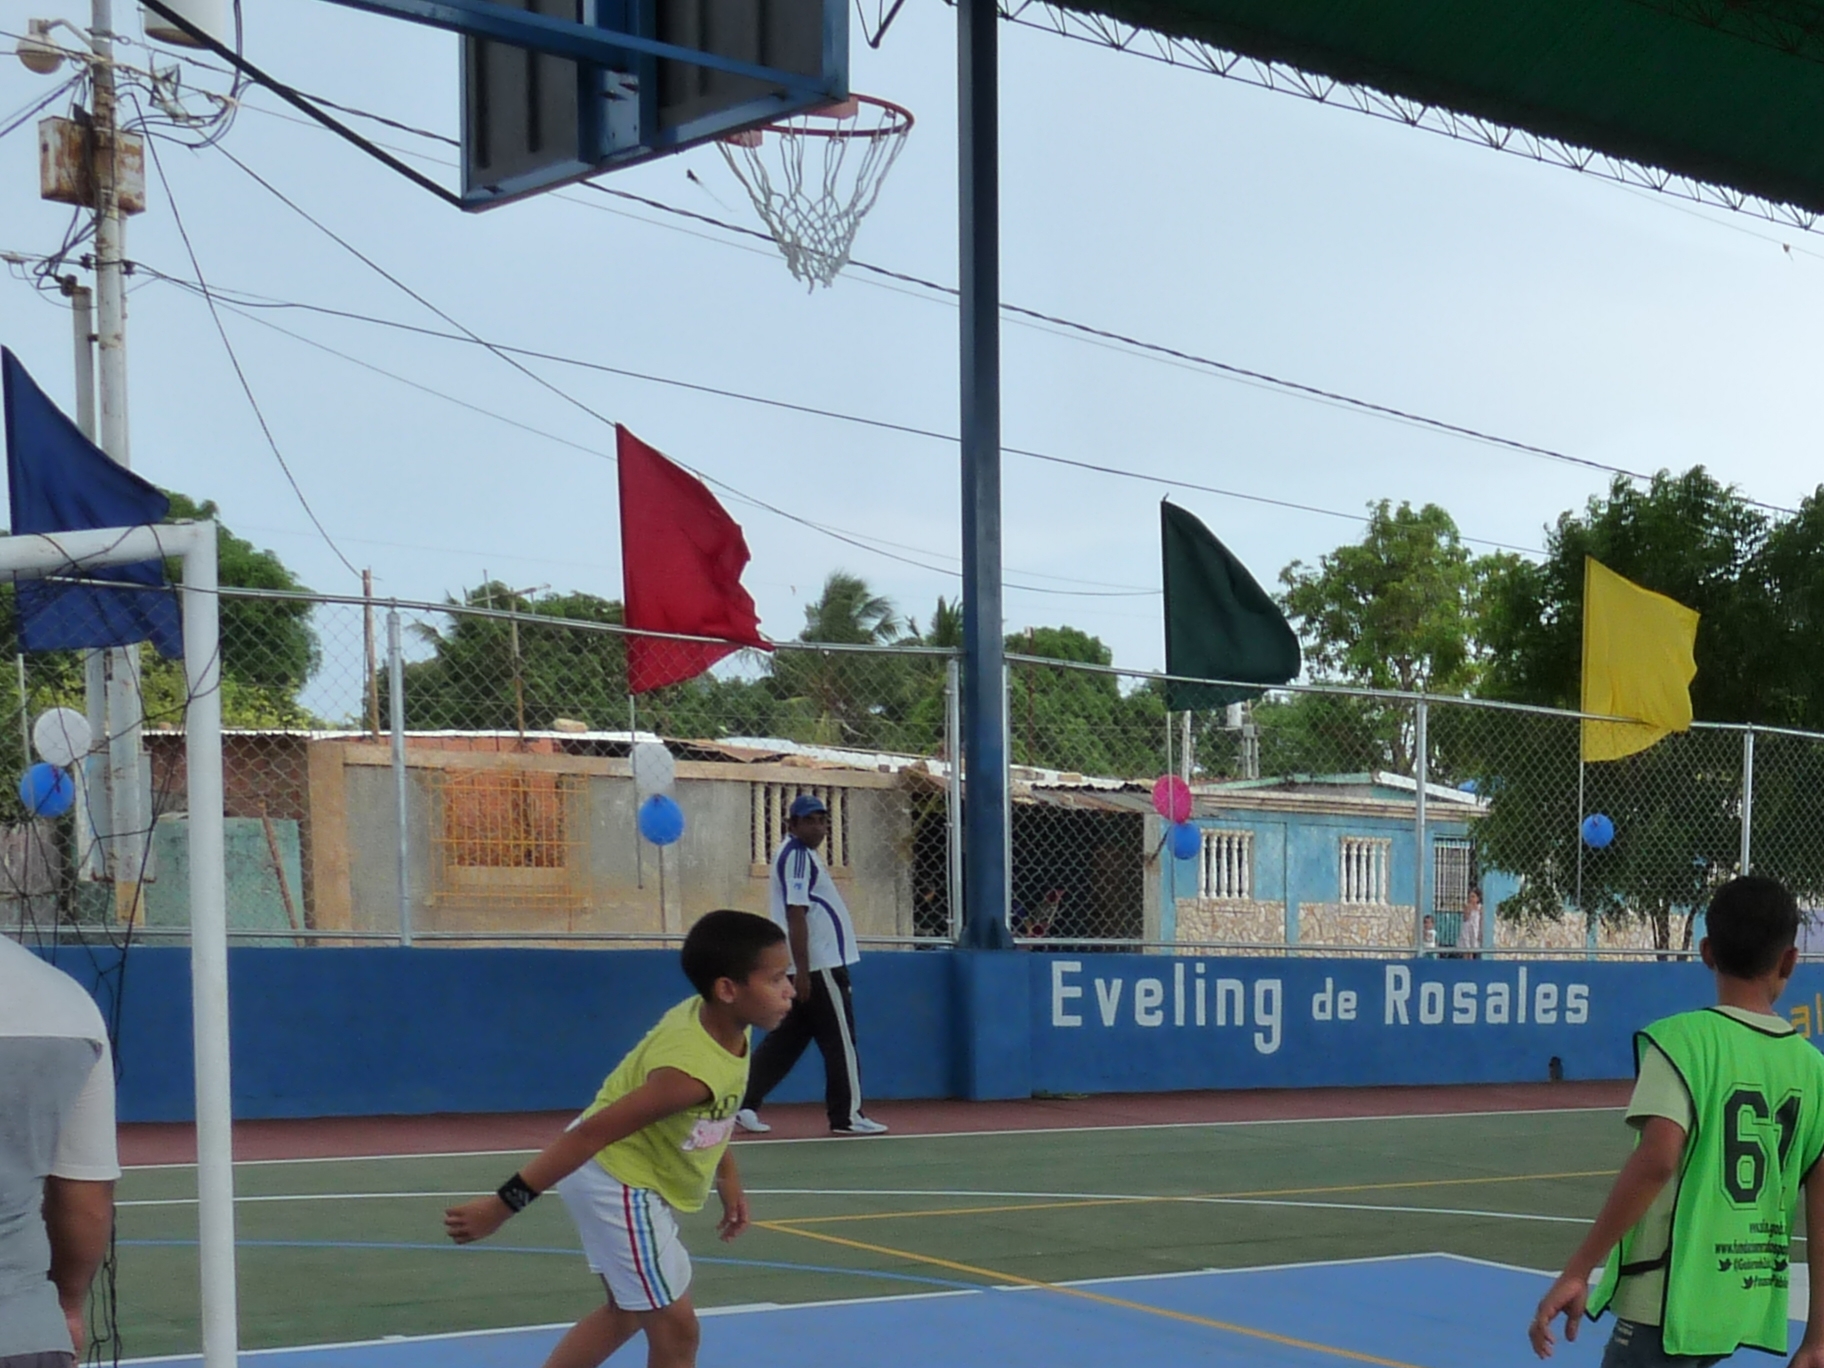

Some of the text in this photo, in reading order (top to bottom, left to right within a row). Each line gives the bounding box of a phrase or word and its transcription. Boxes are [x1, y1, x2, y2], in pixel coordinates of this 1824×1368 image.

[1051, 960, 1589, 1054] Eveling de Rosales
[1720, 1082, 1803, 1212] 61
